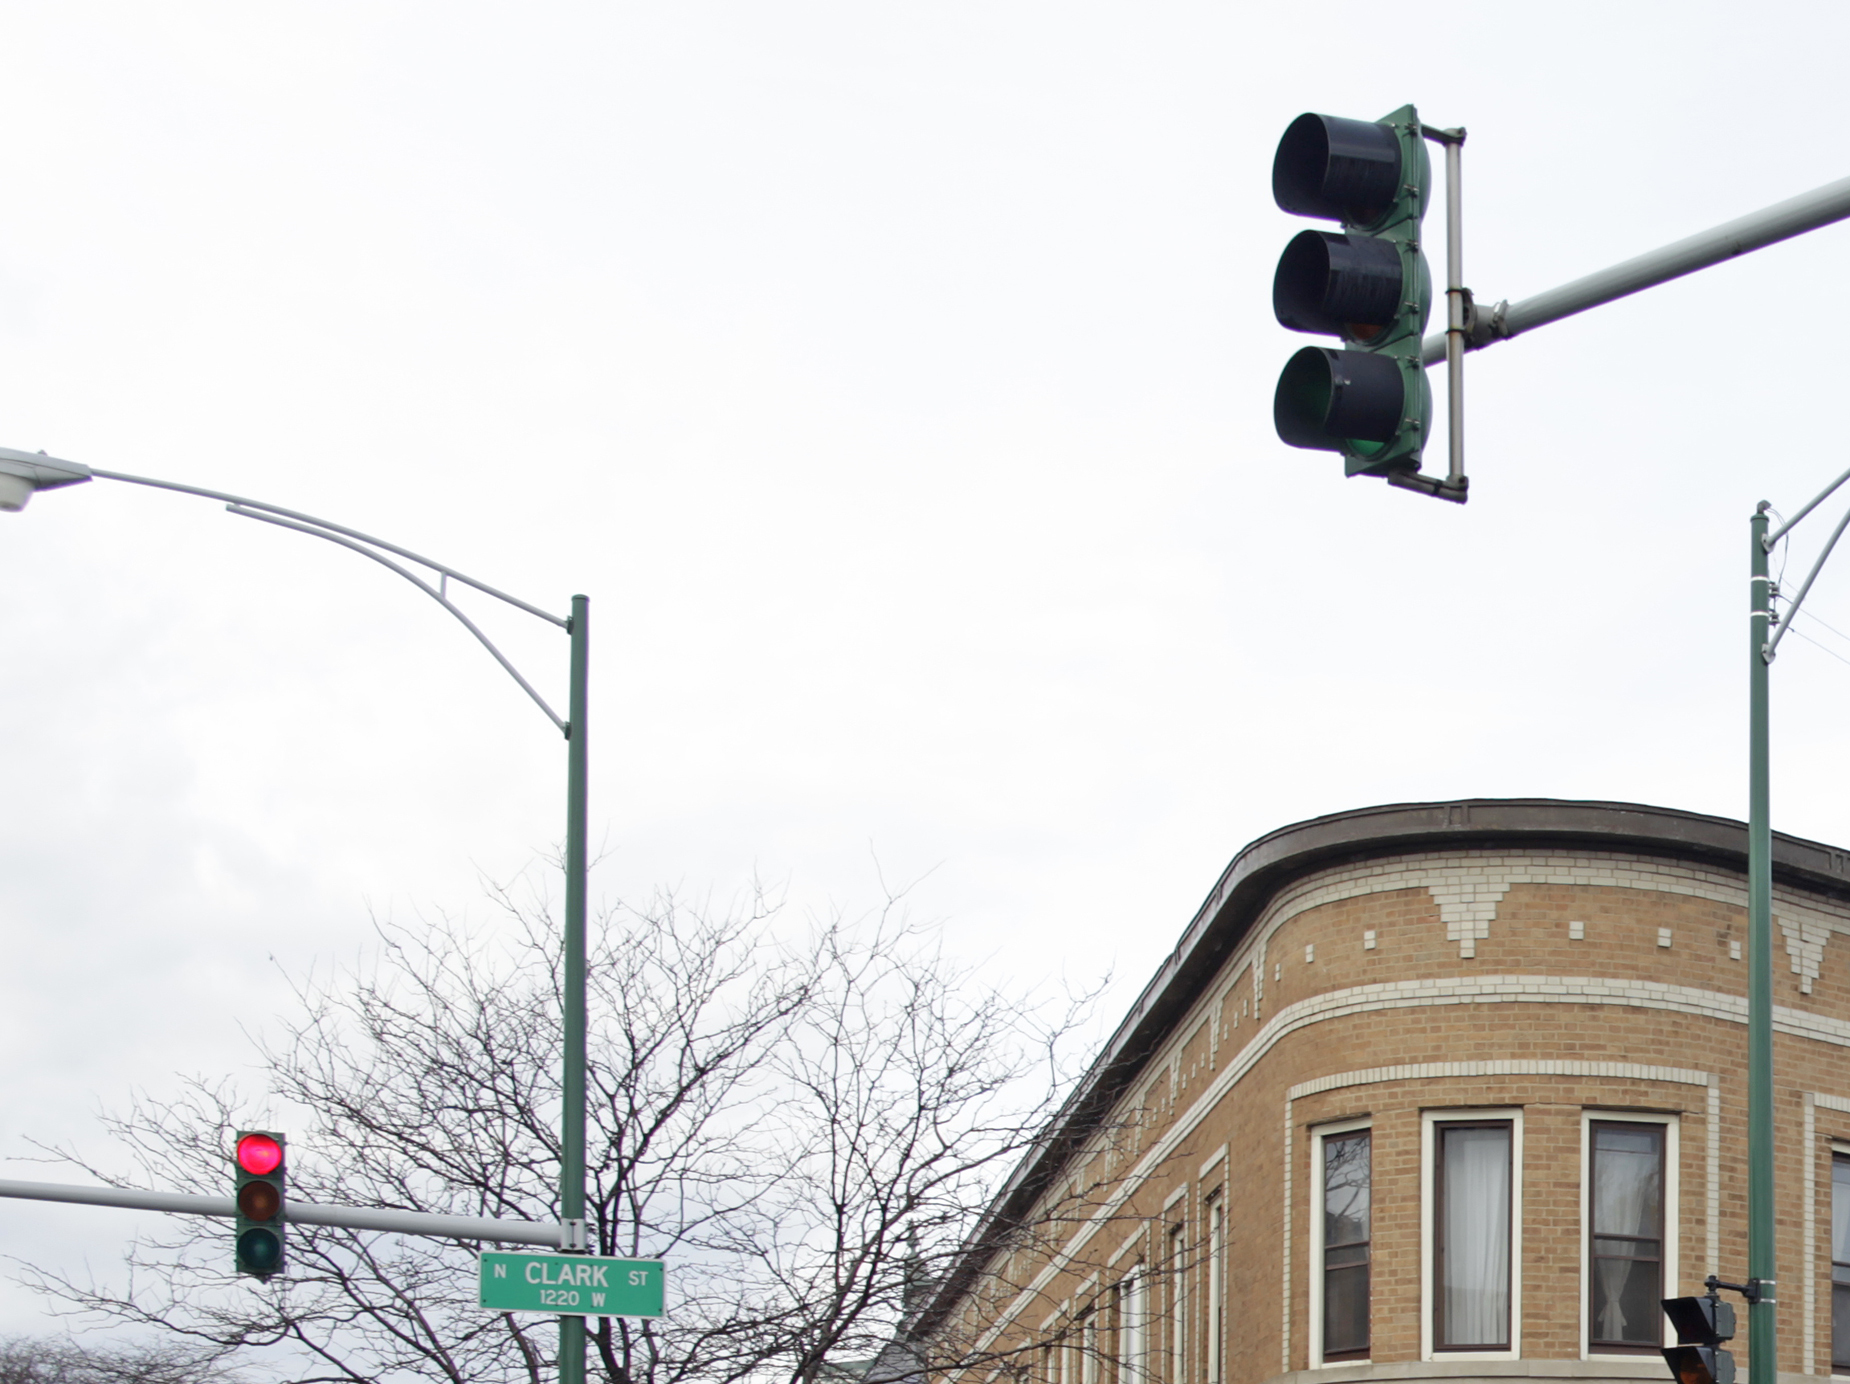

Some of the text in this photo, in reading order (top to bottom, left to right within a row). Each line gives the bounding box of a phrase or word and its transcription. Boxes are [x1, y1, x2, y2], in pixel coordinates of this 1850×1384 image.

[494, 1262, 648, 1288] N CLARK ST
[540, 1290, 606, 1307] 1220 W
